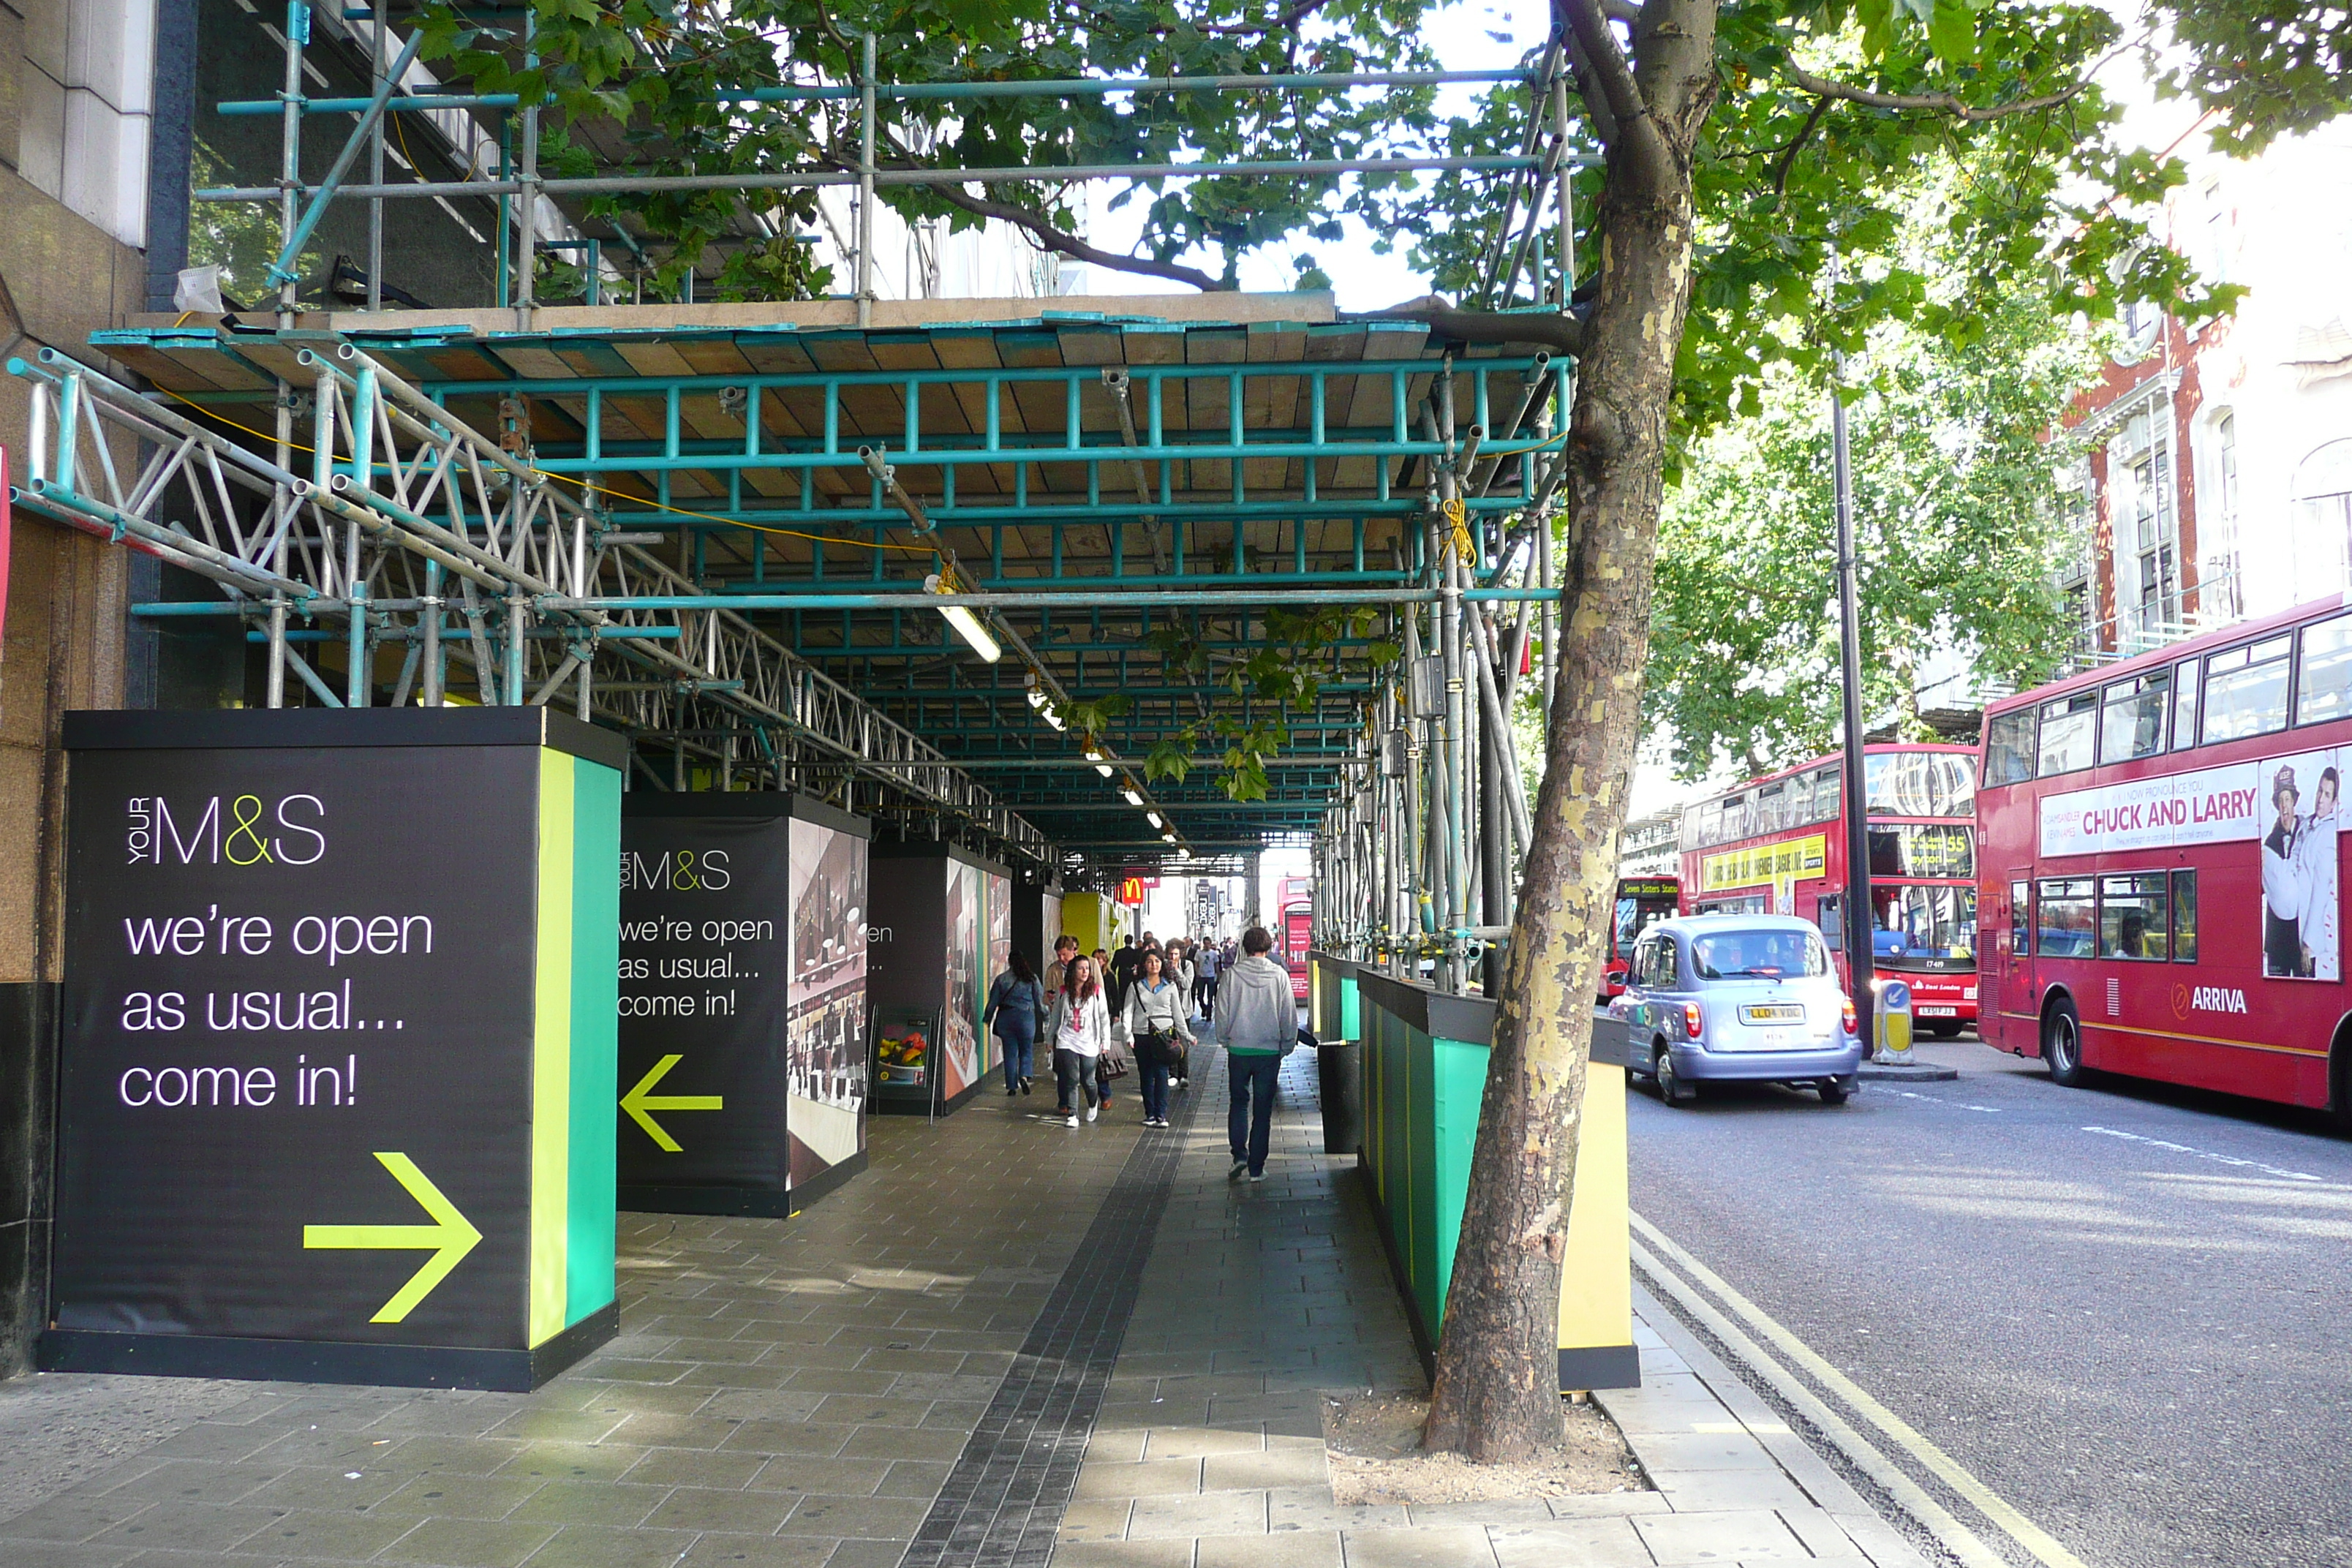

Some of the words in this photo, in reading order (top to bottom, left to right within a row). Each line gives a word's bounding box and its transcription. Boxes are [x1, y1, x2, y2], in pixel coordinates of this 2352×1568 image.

[2127, 788, 2144, 800] NOW
[2146, 782, 2187, 797] PRONOUNCE
[2188, 780, 2204, 791] YOU
[2083, 804, 2142, 834] CHUCK
[2147, 799, 2187, 828] AND
[2193, 788, 2256, 823] LARRY
[127, 796, 150, 864] YOUR
[154, 794, 325, 865] M&S
[1948, 836, 1965, 852] 55
[633, 850, 730, 890] M&S
[1776, 853, 1791, 873] LEAGUE
[1804, 859, 1821, 867] SPORTS
[1911, 856, 1942, 866] eyton
[1624, 883, 1640, 893] Seven
[1642, 883, 1659, 893] Sisters
[1662, 883, 1678, 893] Statio
[1199, 897, 1207, 924] next
[124, 905, 272, 955] we're
[293, 913, 432, 965] open
[619, 915, 692, 941] we're
[702, 921, 773, 947] open
[867, 927, 892, 942] en
[617, 958, 649, 979] as
[660, 951, 758, 979] usual...
[122, 990, 185, 1031] as
[207, 979, 404, 1031] usual...
[617, 995, 695, 1017] come
[706, 989, 735, 1016] in!
[2192, 986, 2247, 1014] ARRIVA
[120, 1066, 276, 1107] come
[298, 1055, 356, 1106] in!
